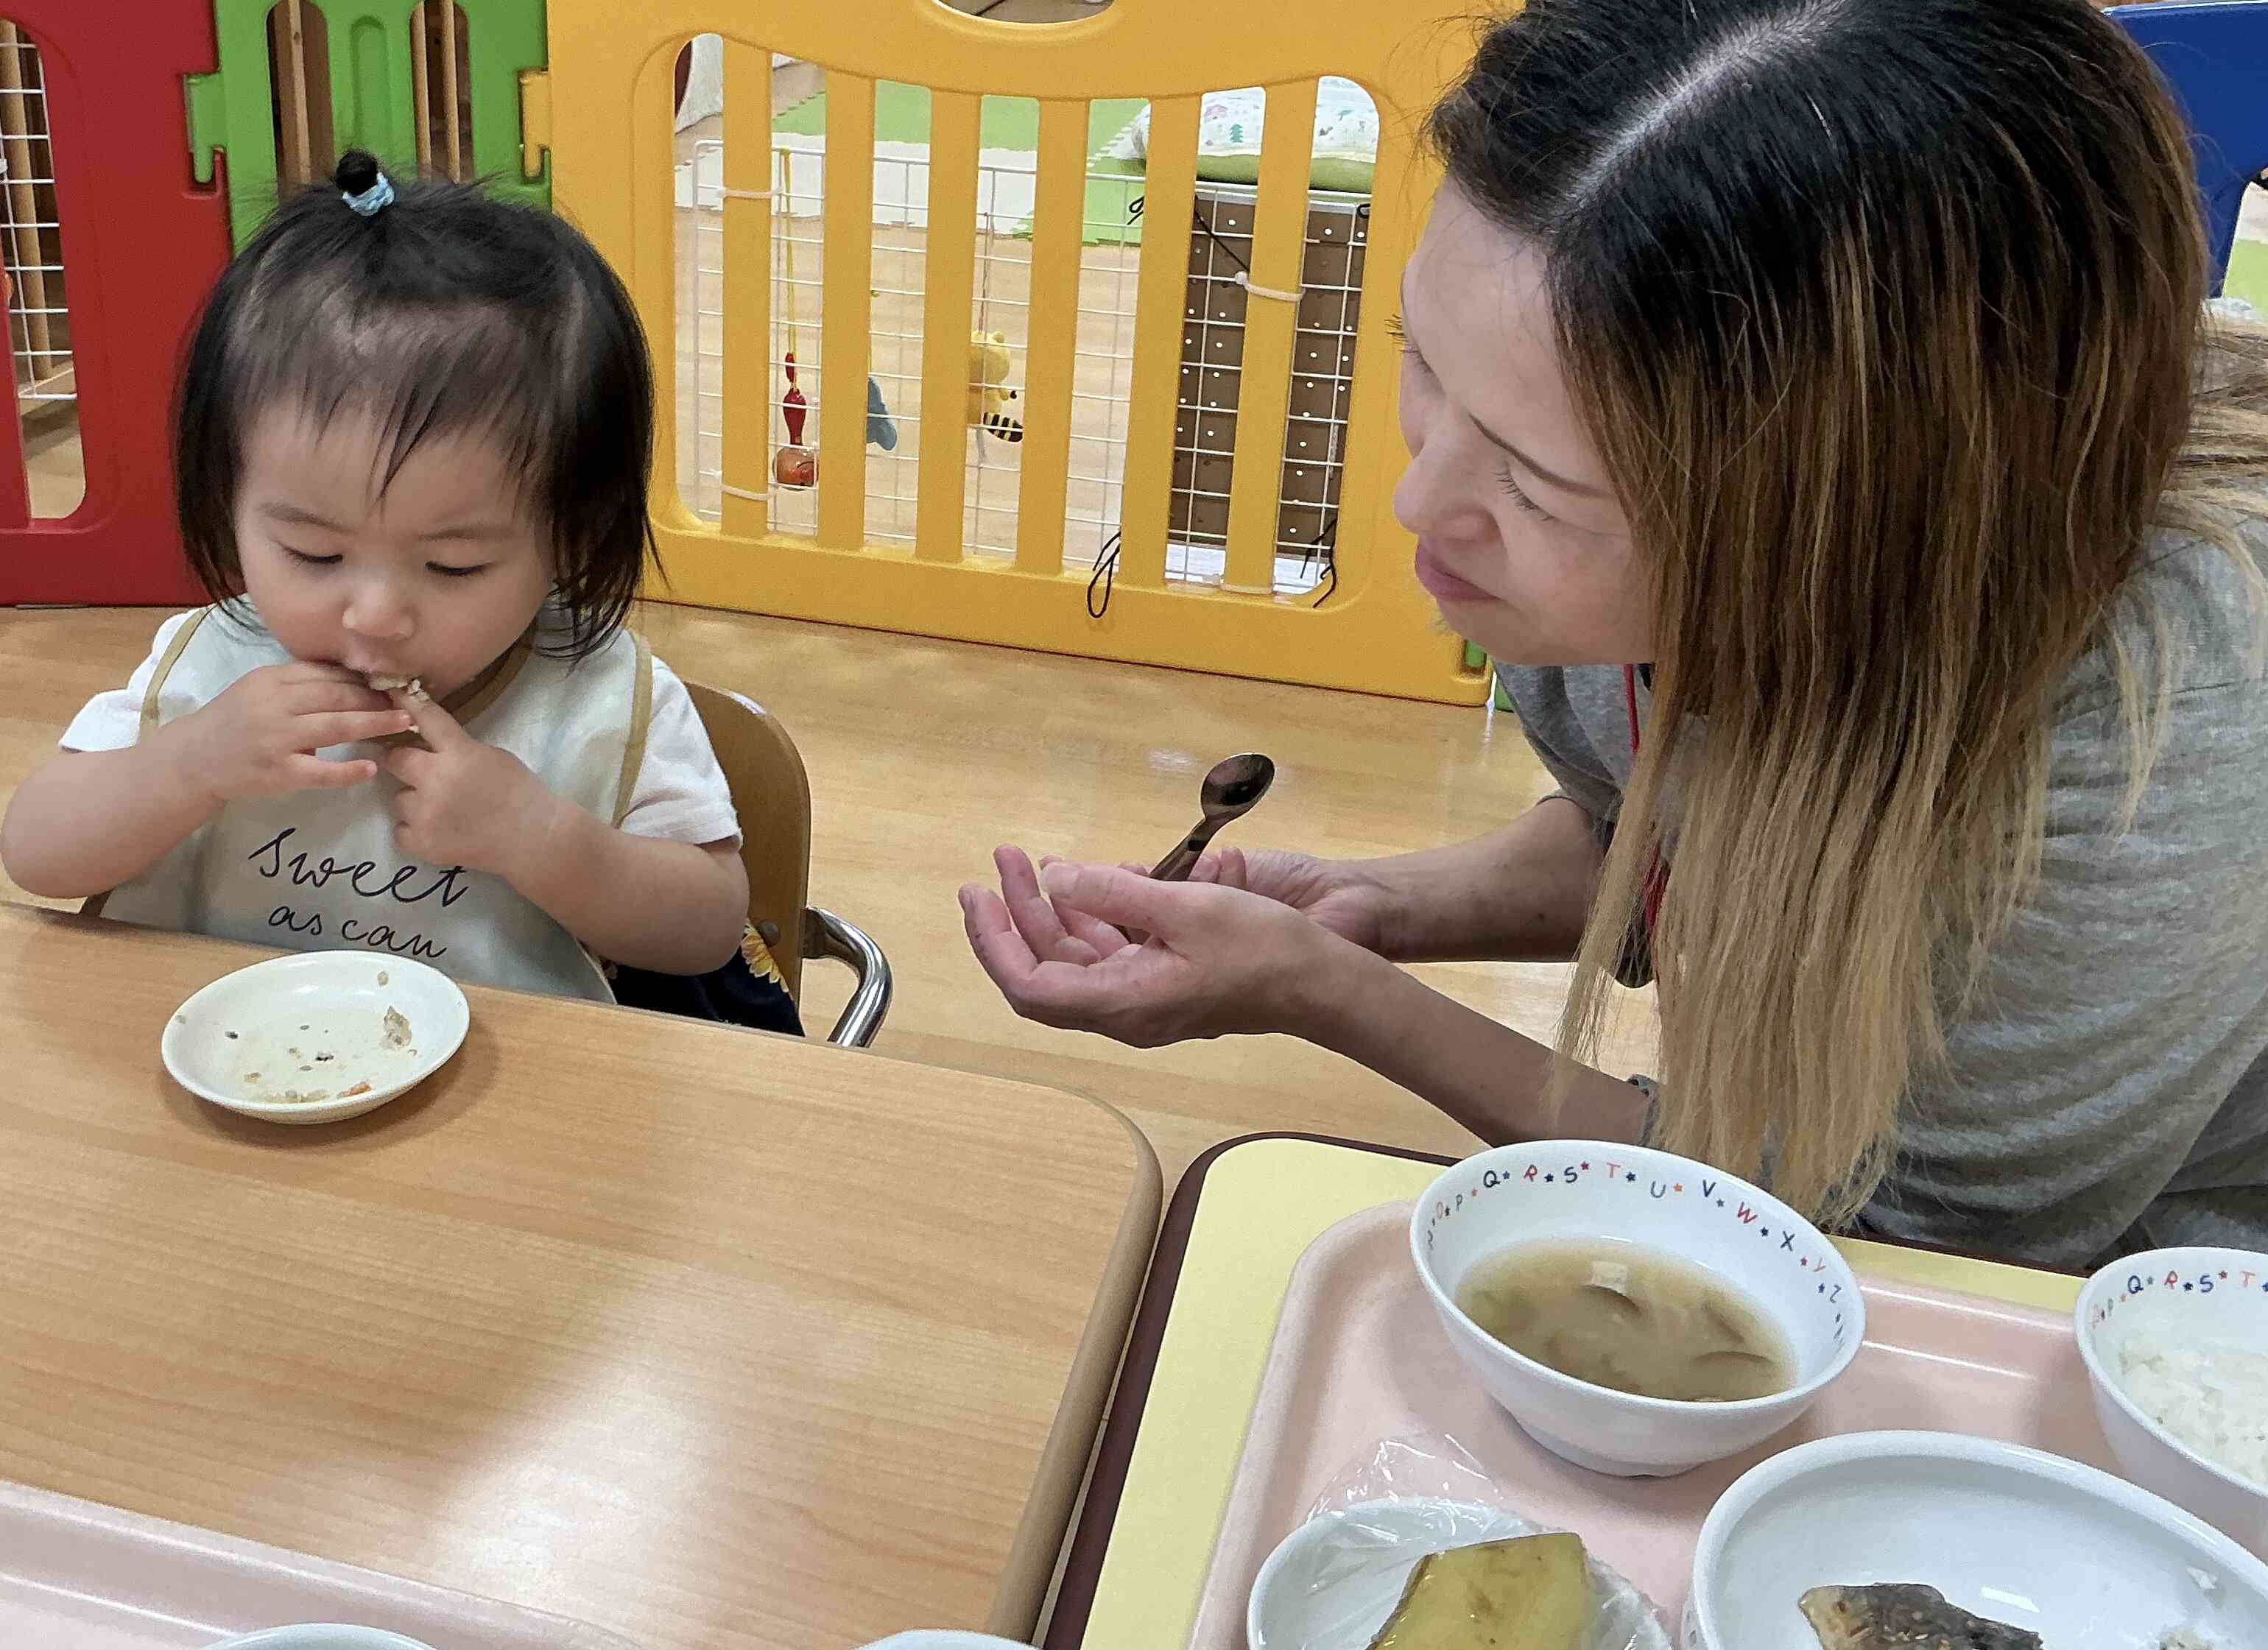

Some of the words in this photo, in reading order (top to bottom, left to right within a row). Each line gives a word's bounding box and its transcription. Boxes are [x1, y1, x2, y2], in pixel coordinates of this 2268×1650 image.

[248, 827, 470, 907] Sweet
[268, 906, 323, 936] as
[341, 920, 448, 958] can
[1483, 1169, 1501, 1188] Q
[1523, 1164, 1538, 1182] R
[1563, 1166, 1579, 1184] S
[1606, 1162, 1621, 1179] T
[1649, 1180, 1667, 1199] U
[1702, 1179, 1717, 1198] V
[1736, 1201, 1759, 1224] W
[1780, 1230, 1796, 1252] X
[2127, 1274, 2144, 1294] Q
[2163, 1270, 2179, 1290] R
[2200, 1274, 2215, 1294] S
[2239, 1270, 2256, 1288] T
